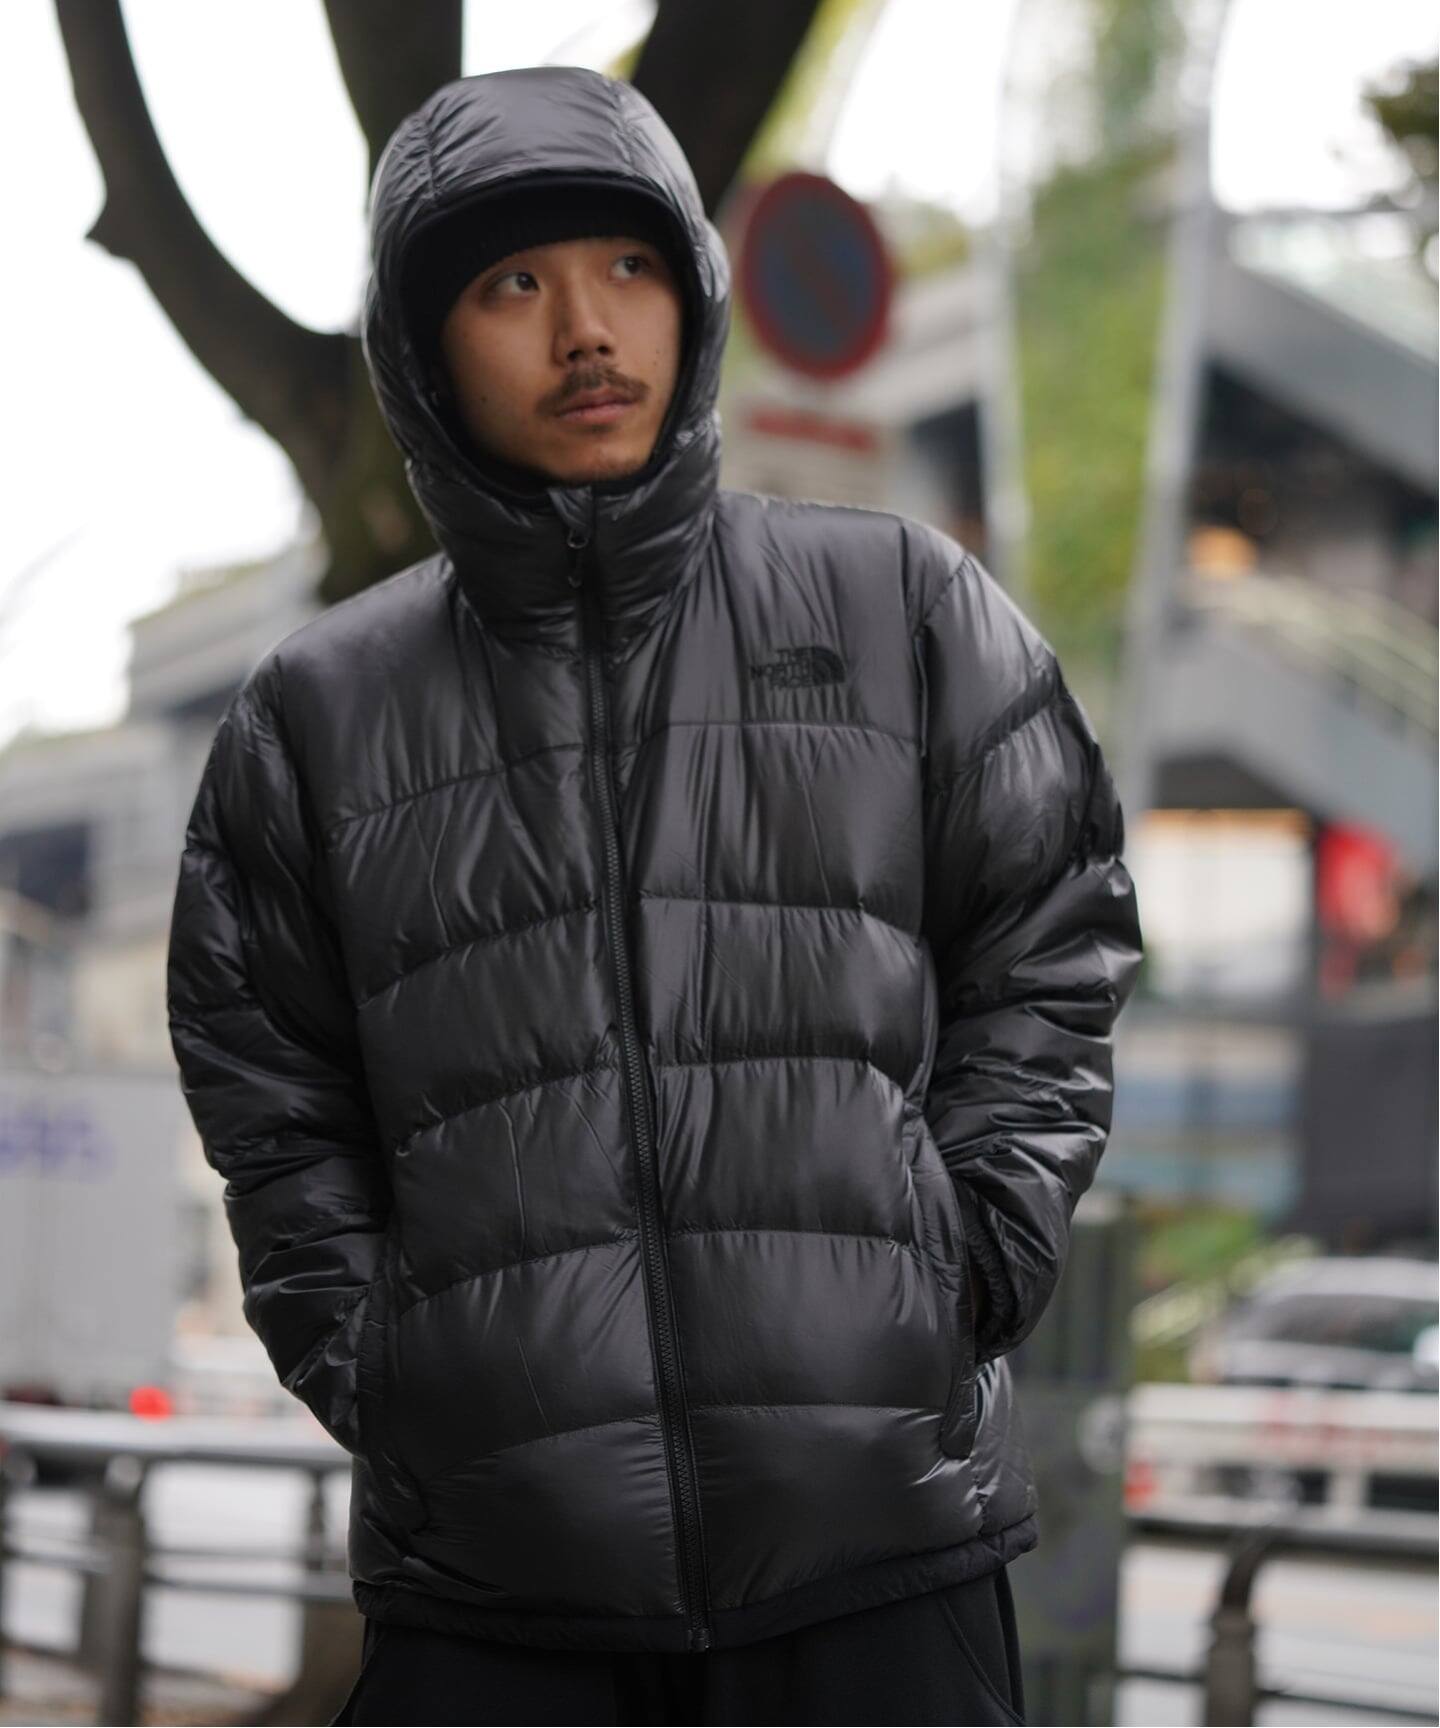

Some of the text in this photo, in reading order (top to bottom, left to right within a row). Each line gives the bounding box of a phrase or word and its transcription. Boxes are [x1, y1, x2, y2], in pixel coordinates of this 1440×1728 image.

[777, 647, 810, 665] THE
[750, 658, 811, 680] NORTH
[769, 675, 812, 690] FACE
